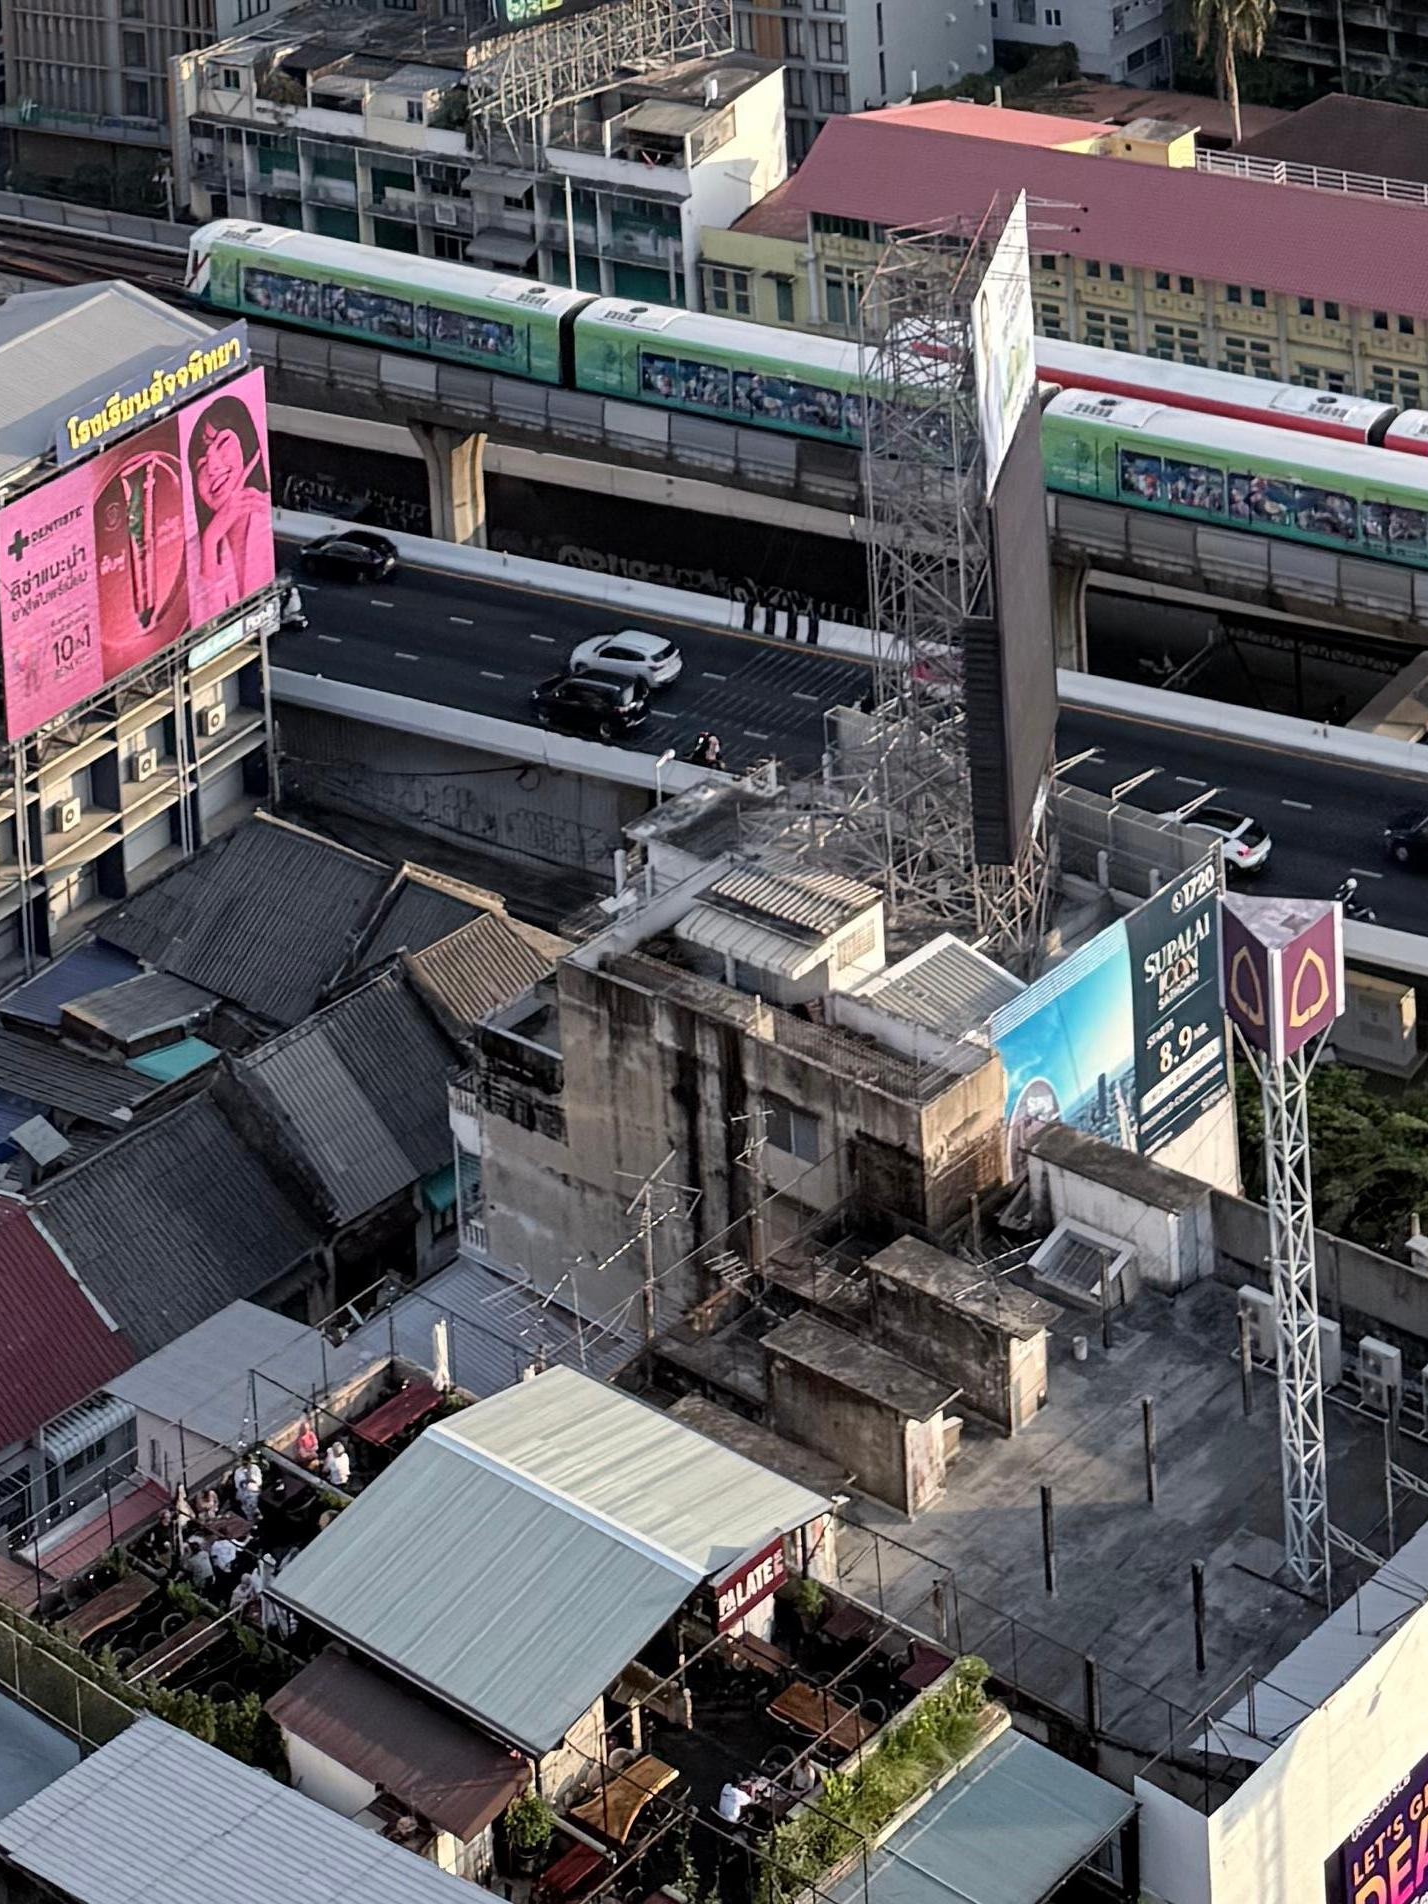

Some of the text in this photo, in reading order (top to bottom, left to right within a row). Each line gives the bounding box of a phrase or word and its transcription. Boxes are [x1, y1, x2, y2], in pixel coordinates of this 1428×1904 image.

[1182, 864, 1216, 907] 1720
[1143, 912, 1211, 984] SUPALAI
[1159, 1024, 1193, 1074] 8.9
[718, 1556, 774, 1617] PALATE
[1352, 1813, 1405, 1887] LET'S
